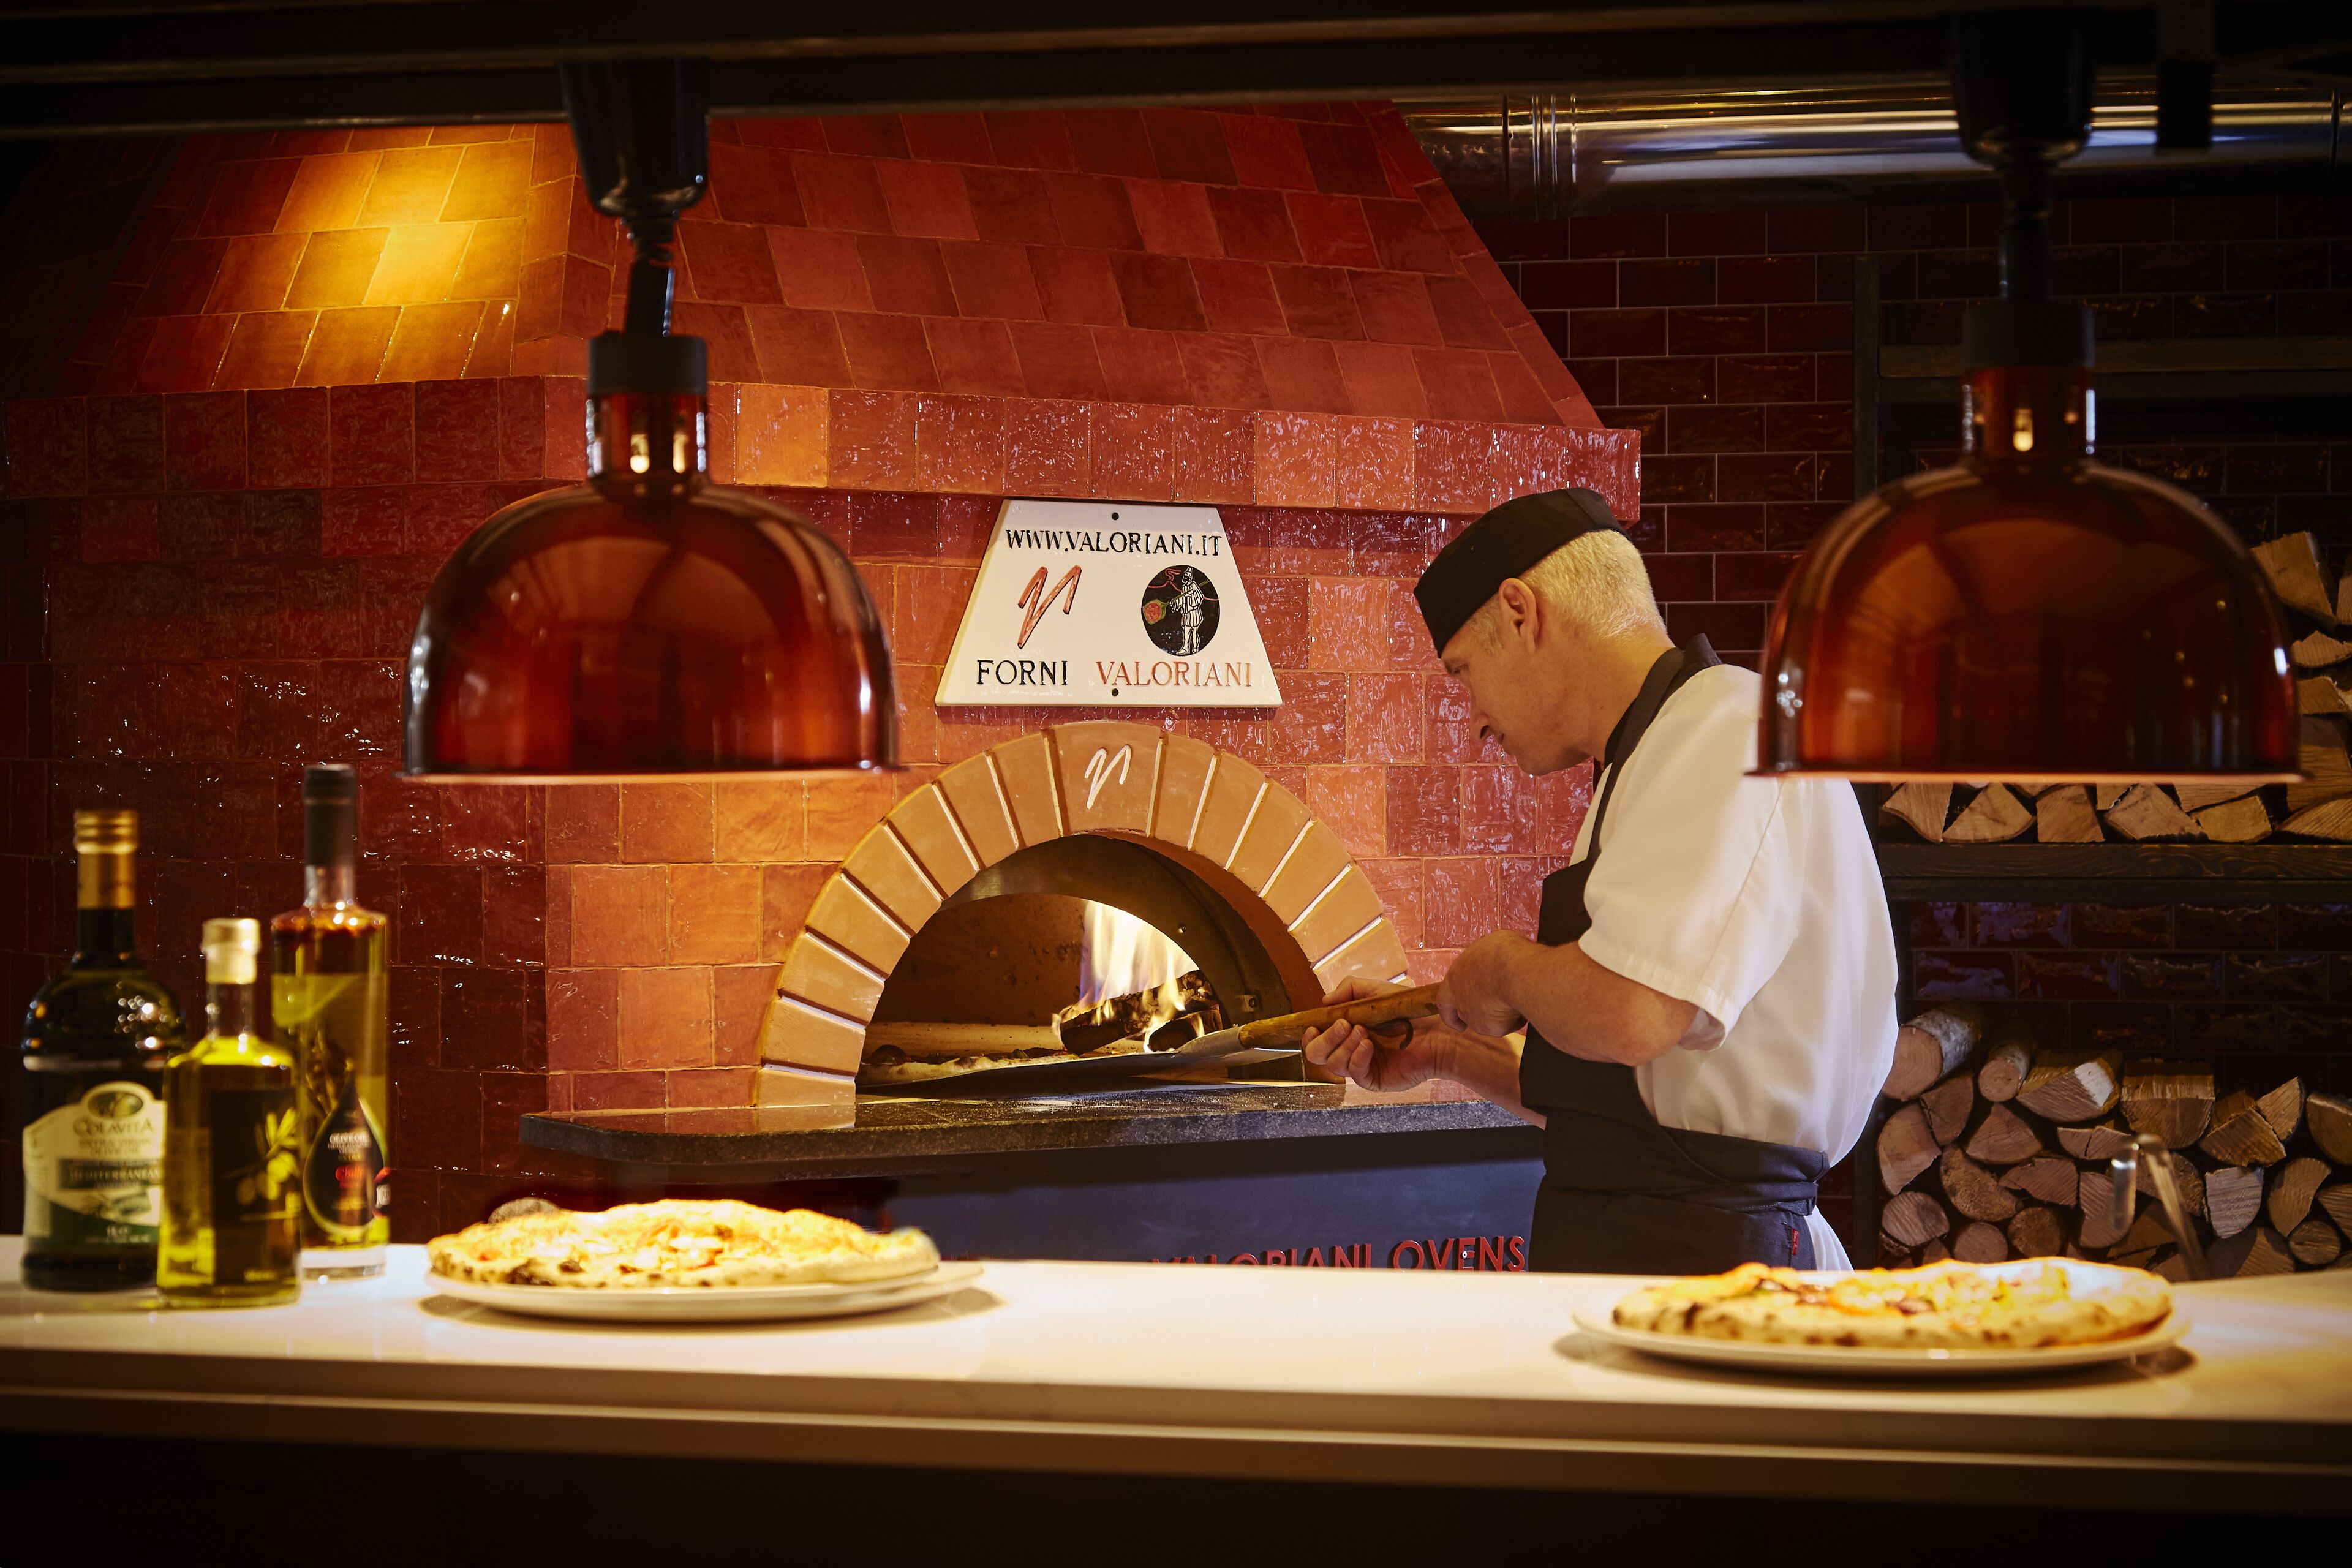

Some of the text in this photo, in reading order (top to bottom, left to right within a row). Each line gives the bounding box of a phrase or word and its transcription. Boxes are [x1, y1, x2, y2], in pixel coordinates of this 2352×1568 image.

[1006, 529, 1223, 556] WWW.VALORIANI.IT
[976, 660, 1252, 687] FORNI VALORIANI
[1393, 1236, 1525, 1272] OVENS
